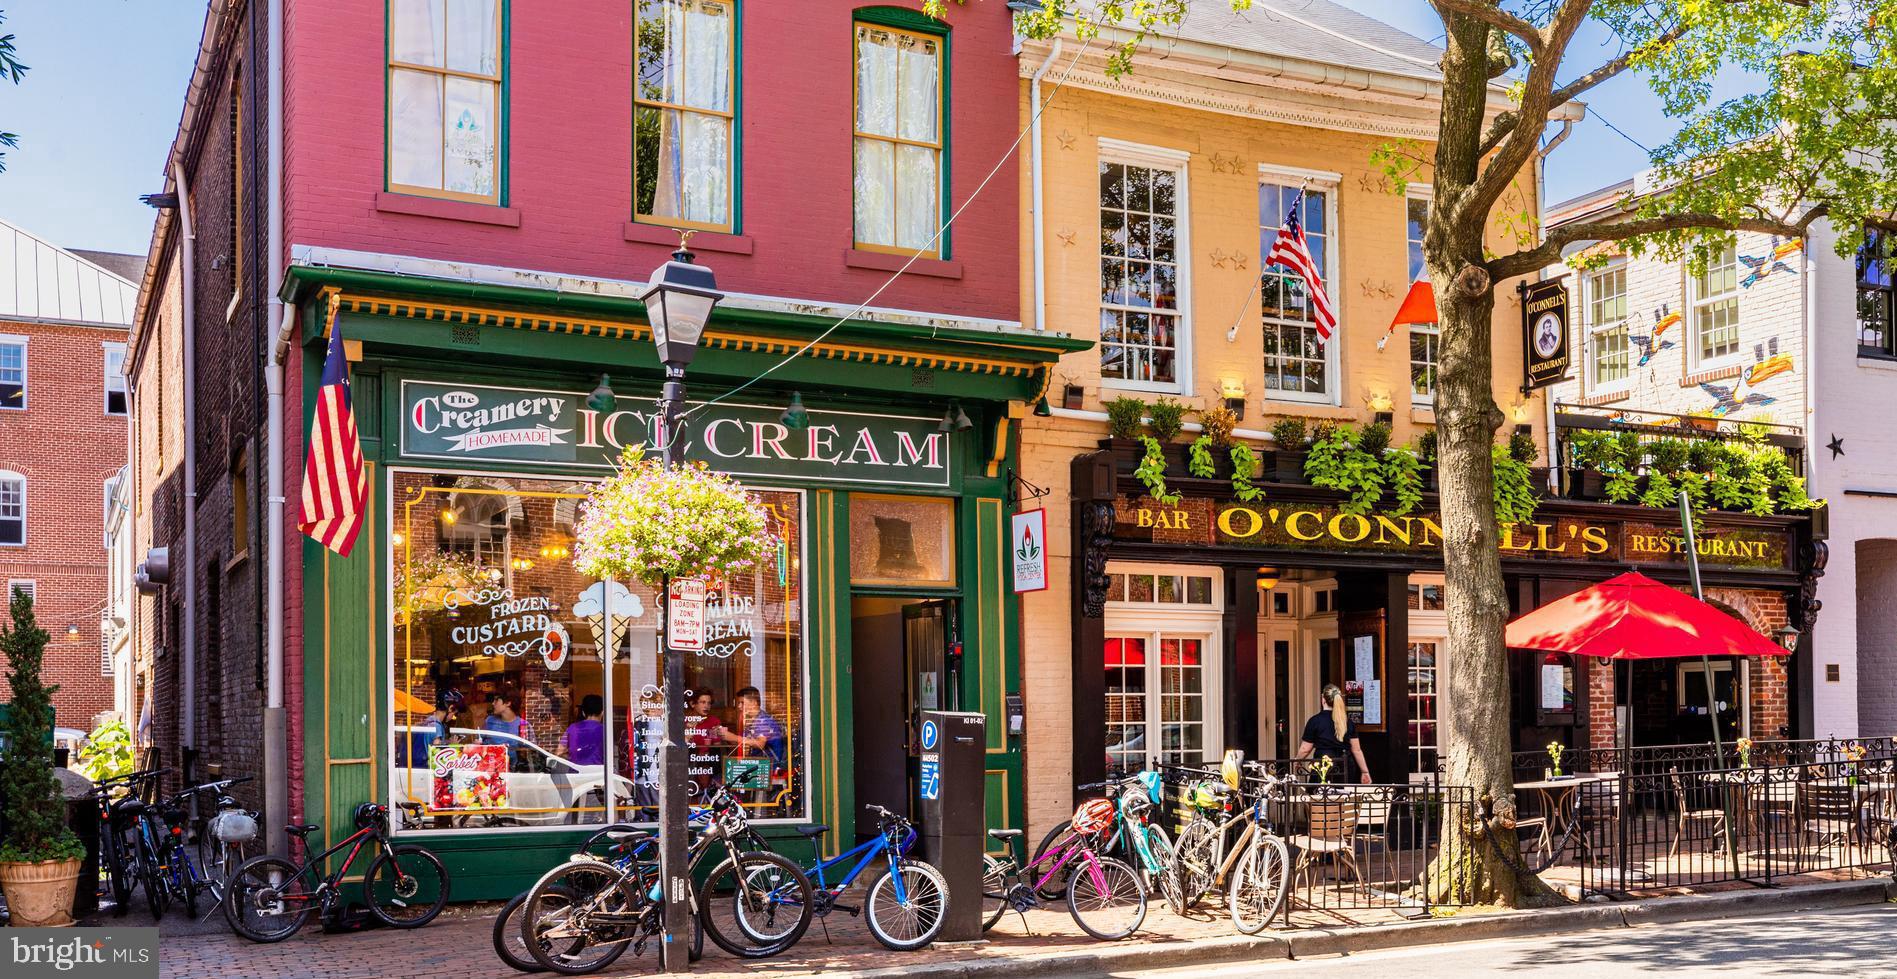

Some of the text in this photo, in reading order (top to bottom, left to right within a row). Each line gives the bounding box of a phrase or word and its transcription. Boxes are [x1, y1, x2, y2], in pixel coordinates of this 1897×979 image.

[1529, 295, 1565, 313] O'CONNELL'S
[1531, 358, 1566, 374] RESTAURANT
[447, 394, 475, 404] The
[411, 395, 566, 434] Creamery
[468, 430, 548, 448] HOMEMADE
[703, 417, 944, 469] CREAM
[1136, 508, 1191, 530] BAR
[1217, 507, 1609, 554] O'CONNLL'S
[491, 596, 551, 620] FROZEN
[674, 601, 700, 609] LOADING
[679, 609, 695, 618] ZONE
[451, 613, 552, 645] CUSTARD
[435, 748, 482, 777] Sorbet
[690, 753, 720, 762] Sorbet
